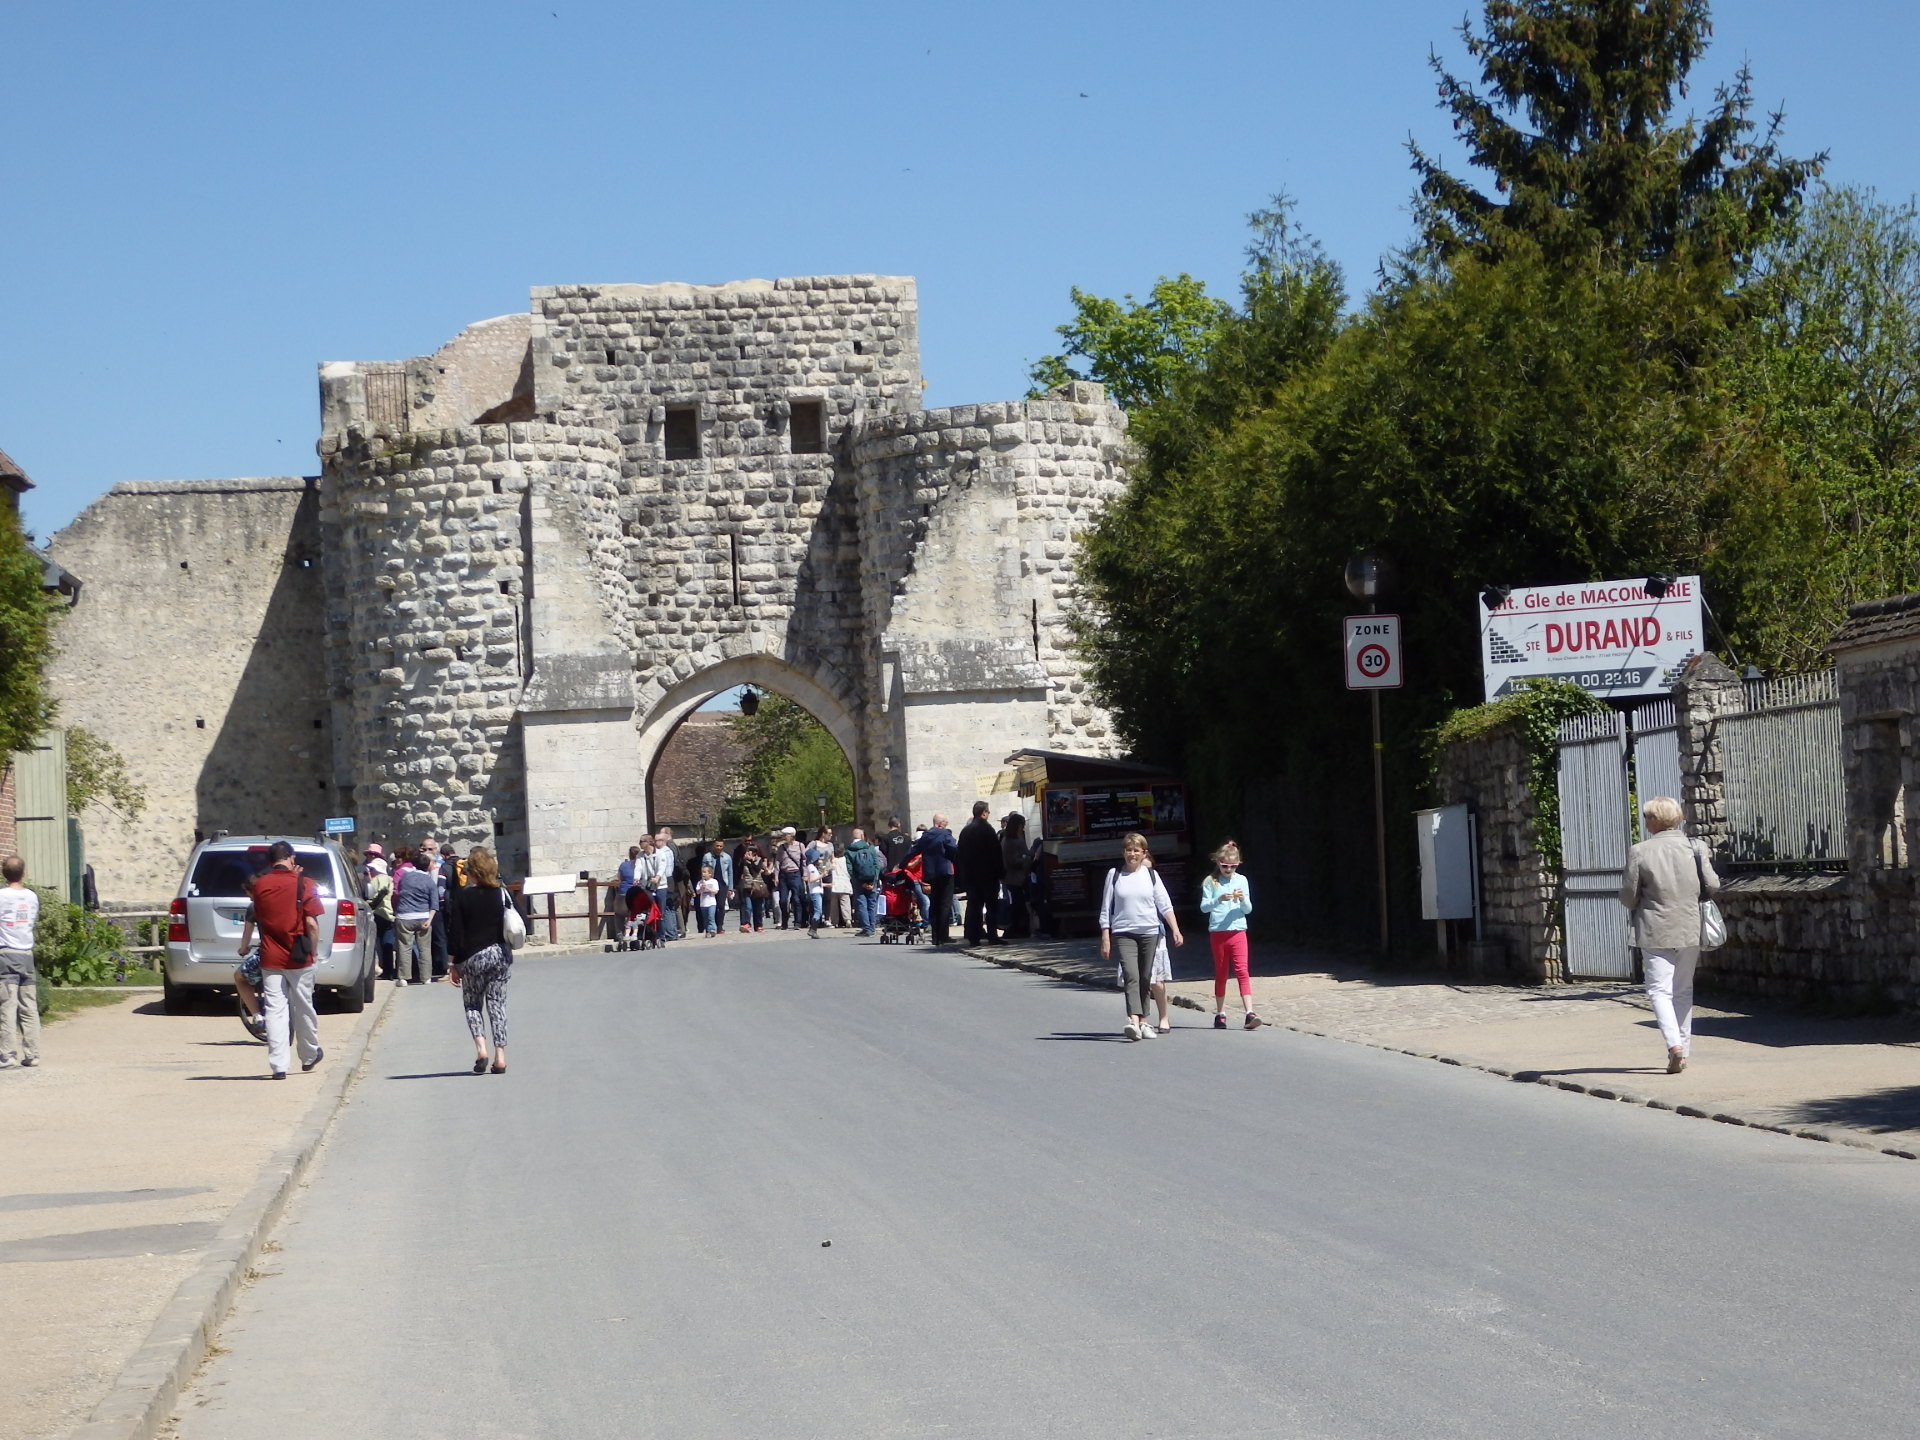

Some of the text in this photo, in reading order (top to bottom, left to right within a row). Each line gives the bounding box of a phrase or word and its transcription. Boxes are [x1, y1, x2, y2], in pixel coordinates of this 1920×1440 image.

[1489, 582, 1691, 611] nt. Gle de MAÇONRIE
[1355, 624, 1390, 635] ZONE
[1525, 616, 1693, 654] STE DURAND & FILS
[1364, 654, 1383, 667] 30
